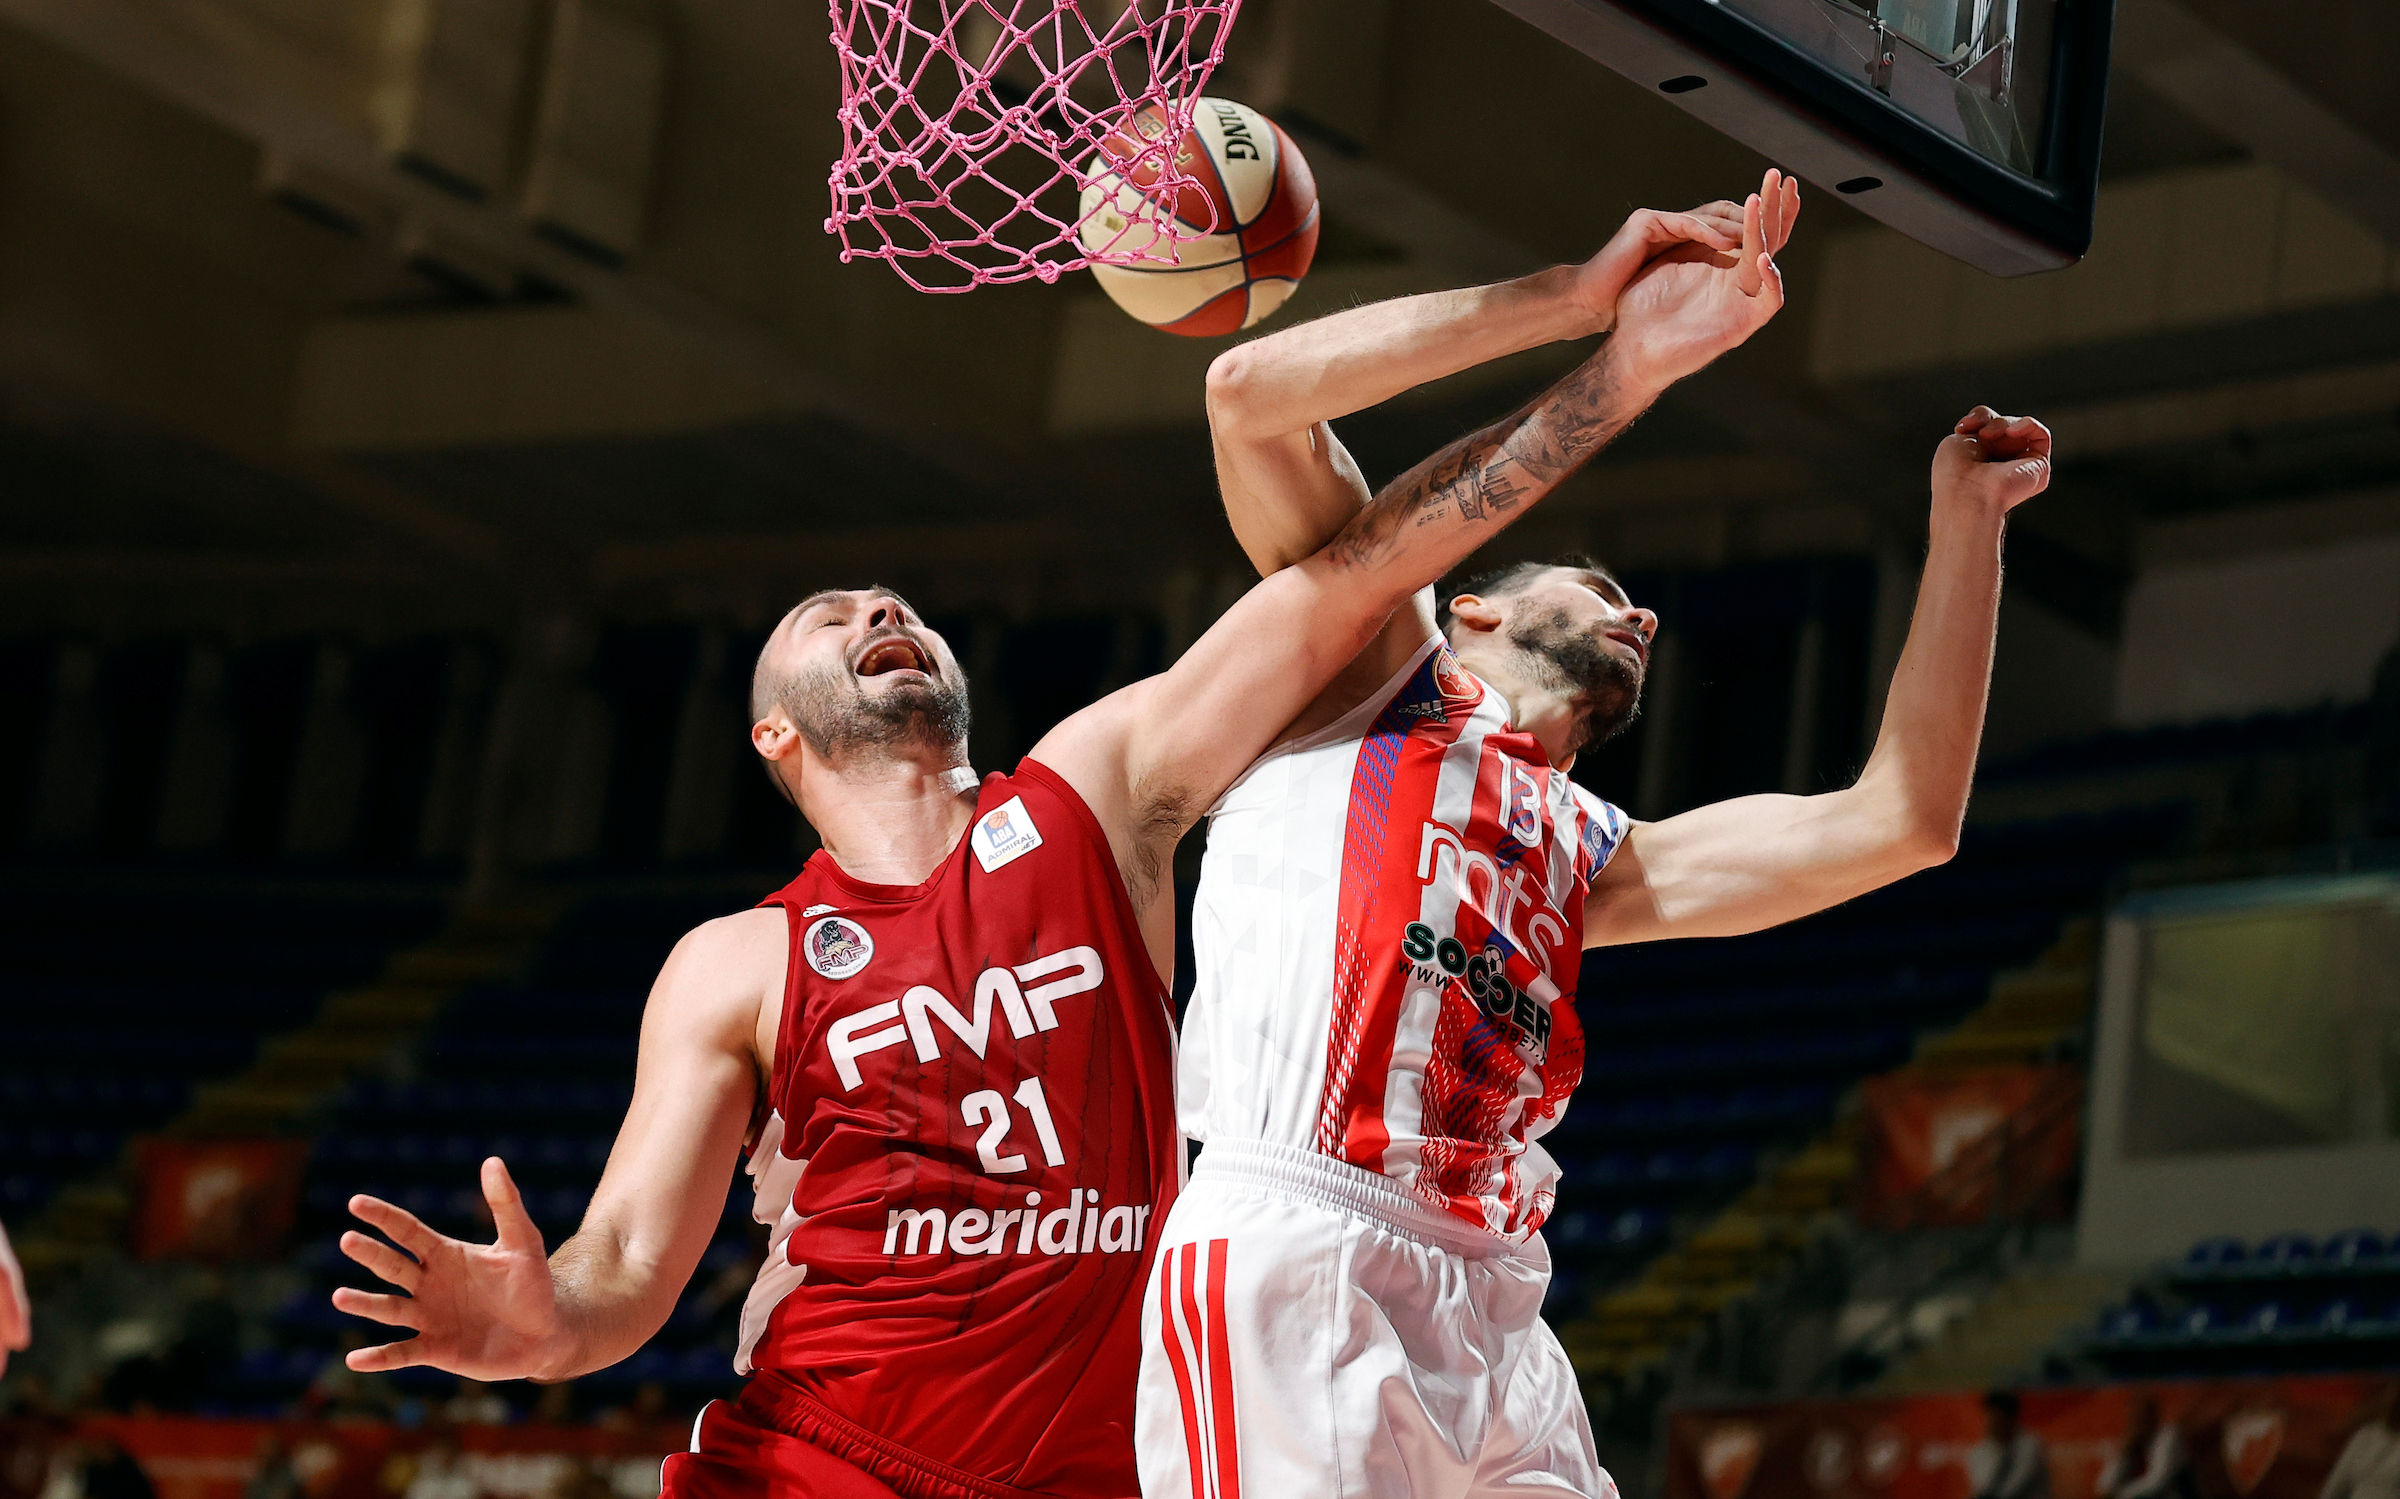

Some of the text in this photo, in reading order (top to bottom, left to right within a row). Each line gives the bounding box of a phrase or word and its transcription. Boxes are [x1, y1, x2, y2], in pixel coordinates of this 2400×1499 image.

[1211, 102, 1260, 161] DING
[992, 825, 1015, 846] ABA
[1497, 750, 1544, 848] 13
[988, 833, 1035, 863] ADMIRAL
[1417, 821, 1564, 979] mts
[816, 944, 869, 972] FMP
[825, 945, 1105, 1093] FMP
[960, 1075, 1067, 1174] 21
